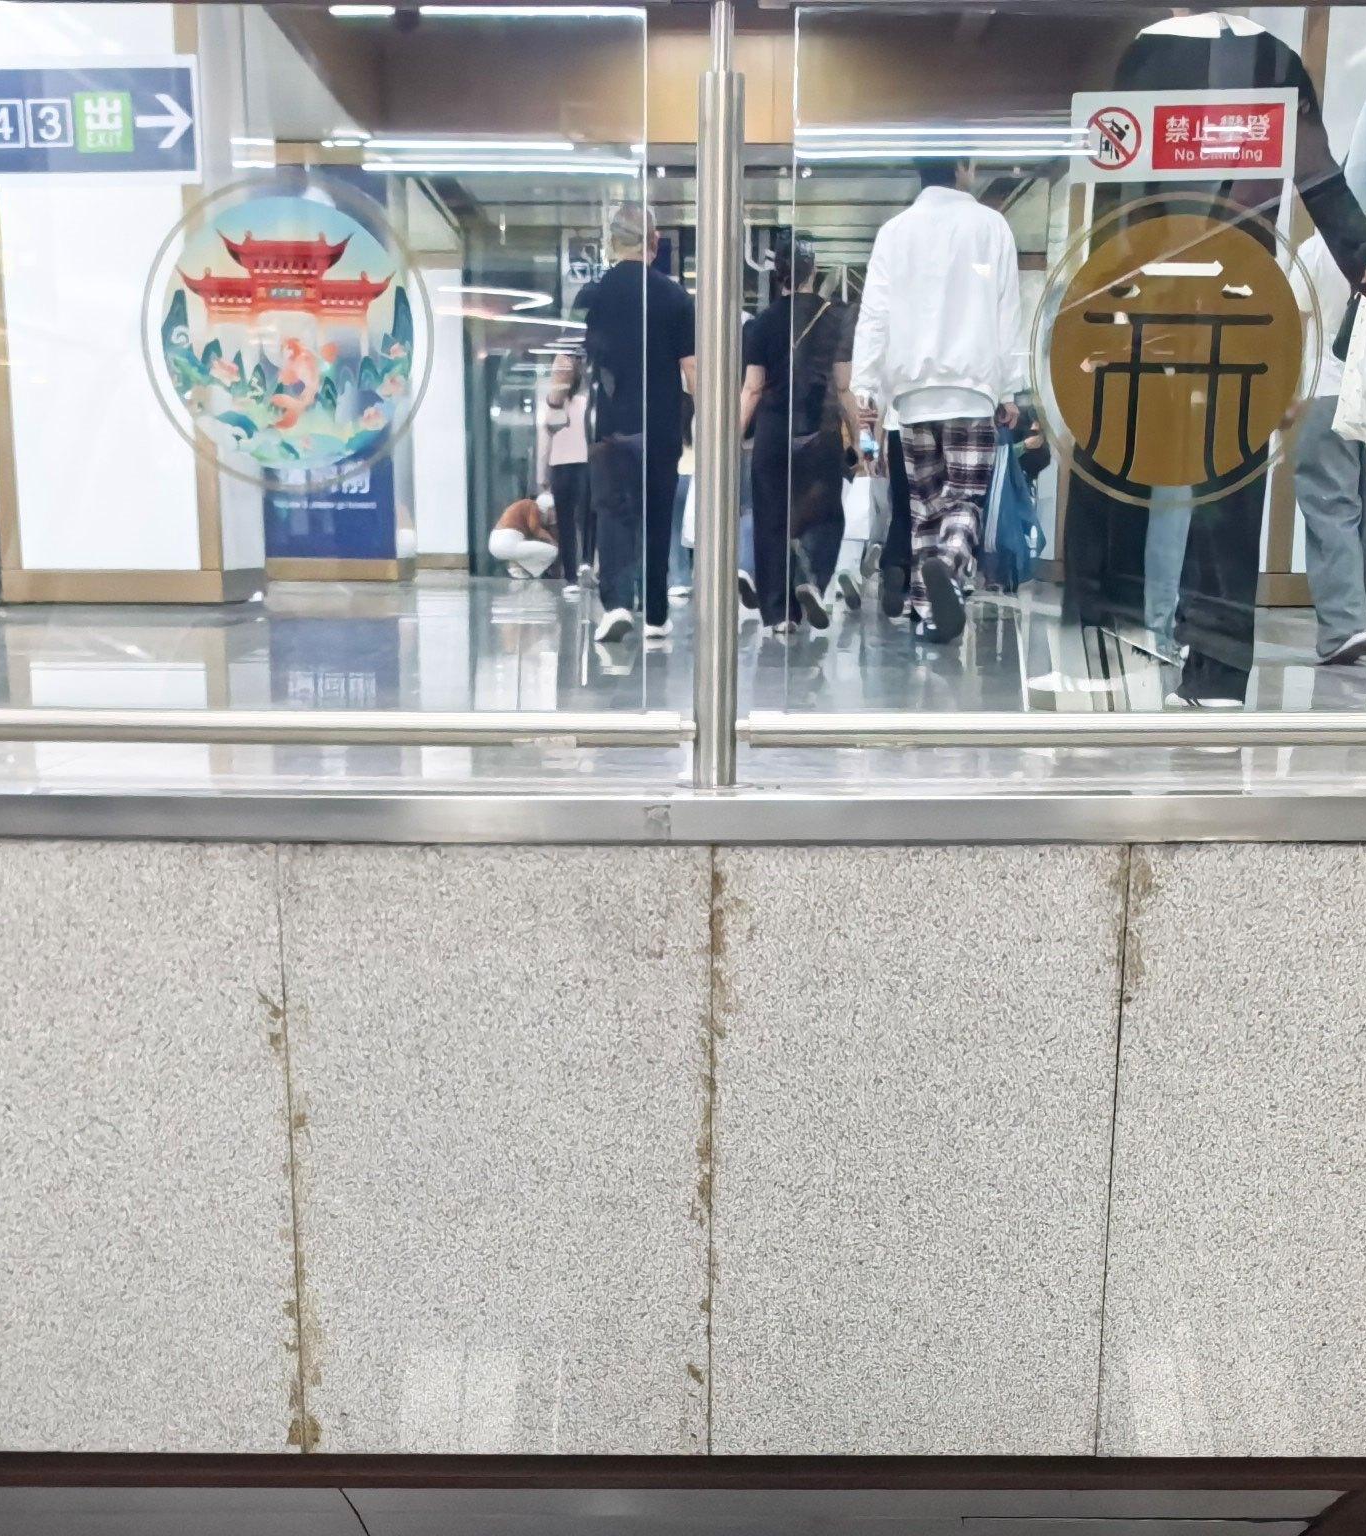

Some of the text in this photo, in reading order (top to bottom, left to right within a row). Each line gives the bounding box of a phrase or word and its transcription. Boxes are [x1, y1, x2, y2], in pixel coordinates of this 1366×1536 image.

[38, 106, 62, 140] 3
[84, 97, 123, 129] 出
[86, 130, 123, 147] EXIT
[1174, 149, 1195, 161] No
